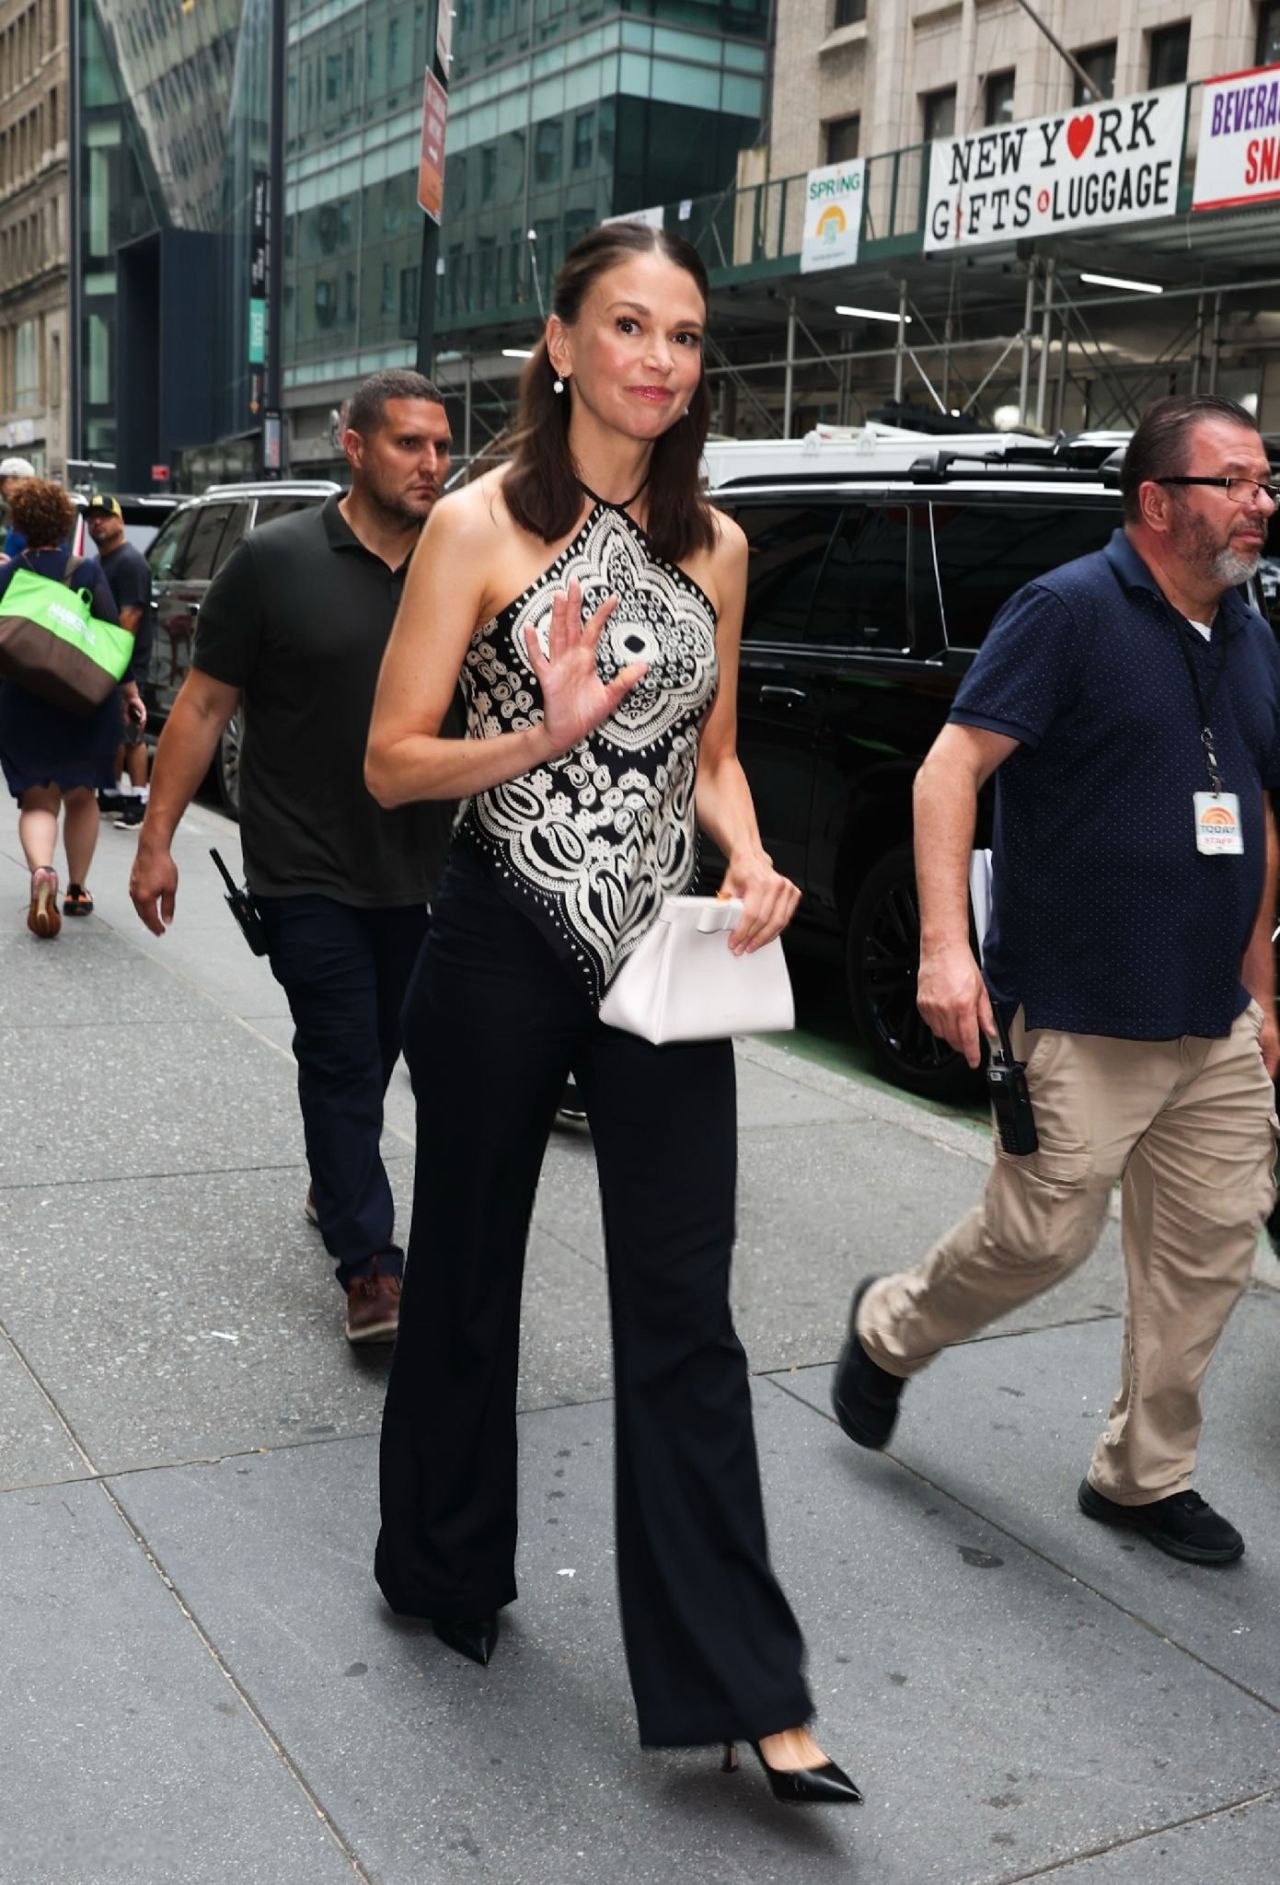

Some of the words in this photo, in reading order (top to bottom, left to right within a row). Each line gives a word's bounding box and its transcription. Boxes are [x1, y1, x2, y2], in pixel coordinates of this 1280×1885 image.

[1211, 81, 1280, 138] BEVERA
[949, 127, 1027, 185] NEW
[1052, 161, 1172, 221] LUGGAGE
